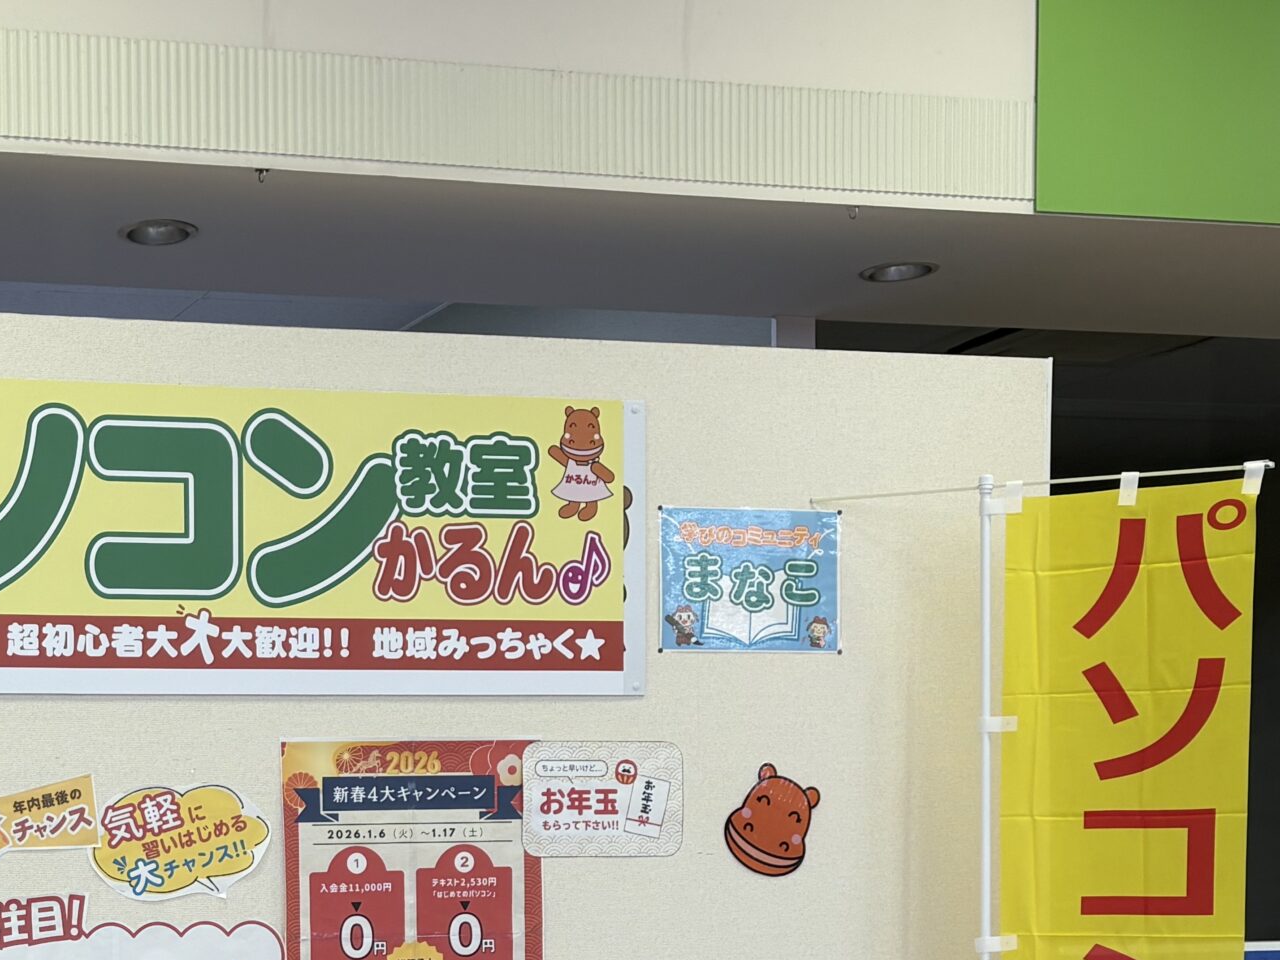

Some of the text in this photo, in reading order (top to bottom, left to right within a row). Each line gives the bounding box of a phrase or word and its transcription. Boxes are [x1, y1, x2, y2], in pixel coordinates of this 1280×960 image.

[683, 550, 821, 614] まなこ
[385, 751, 442, 775] 2026
[12, 787, 82, 815] 年内最後の
[332, 786, 488, 804] 新春4大キャンペーン
[540, 787, 619, 815] お年玉
[12, 805, 94, 845] チャンス
[102, 790, 207, 849] 気軽に
[541, 819, 620, 832] もらって下さい!!
[141, 815, 248, 861] 習いはじめる
[129, 838, 248, 895] 大チャンス!!
[320, 883, 393, 893] 入会金11,000円
[431, 877, 497, 888] テキスト2,530円
